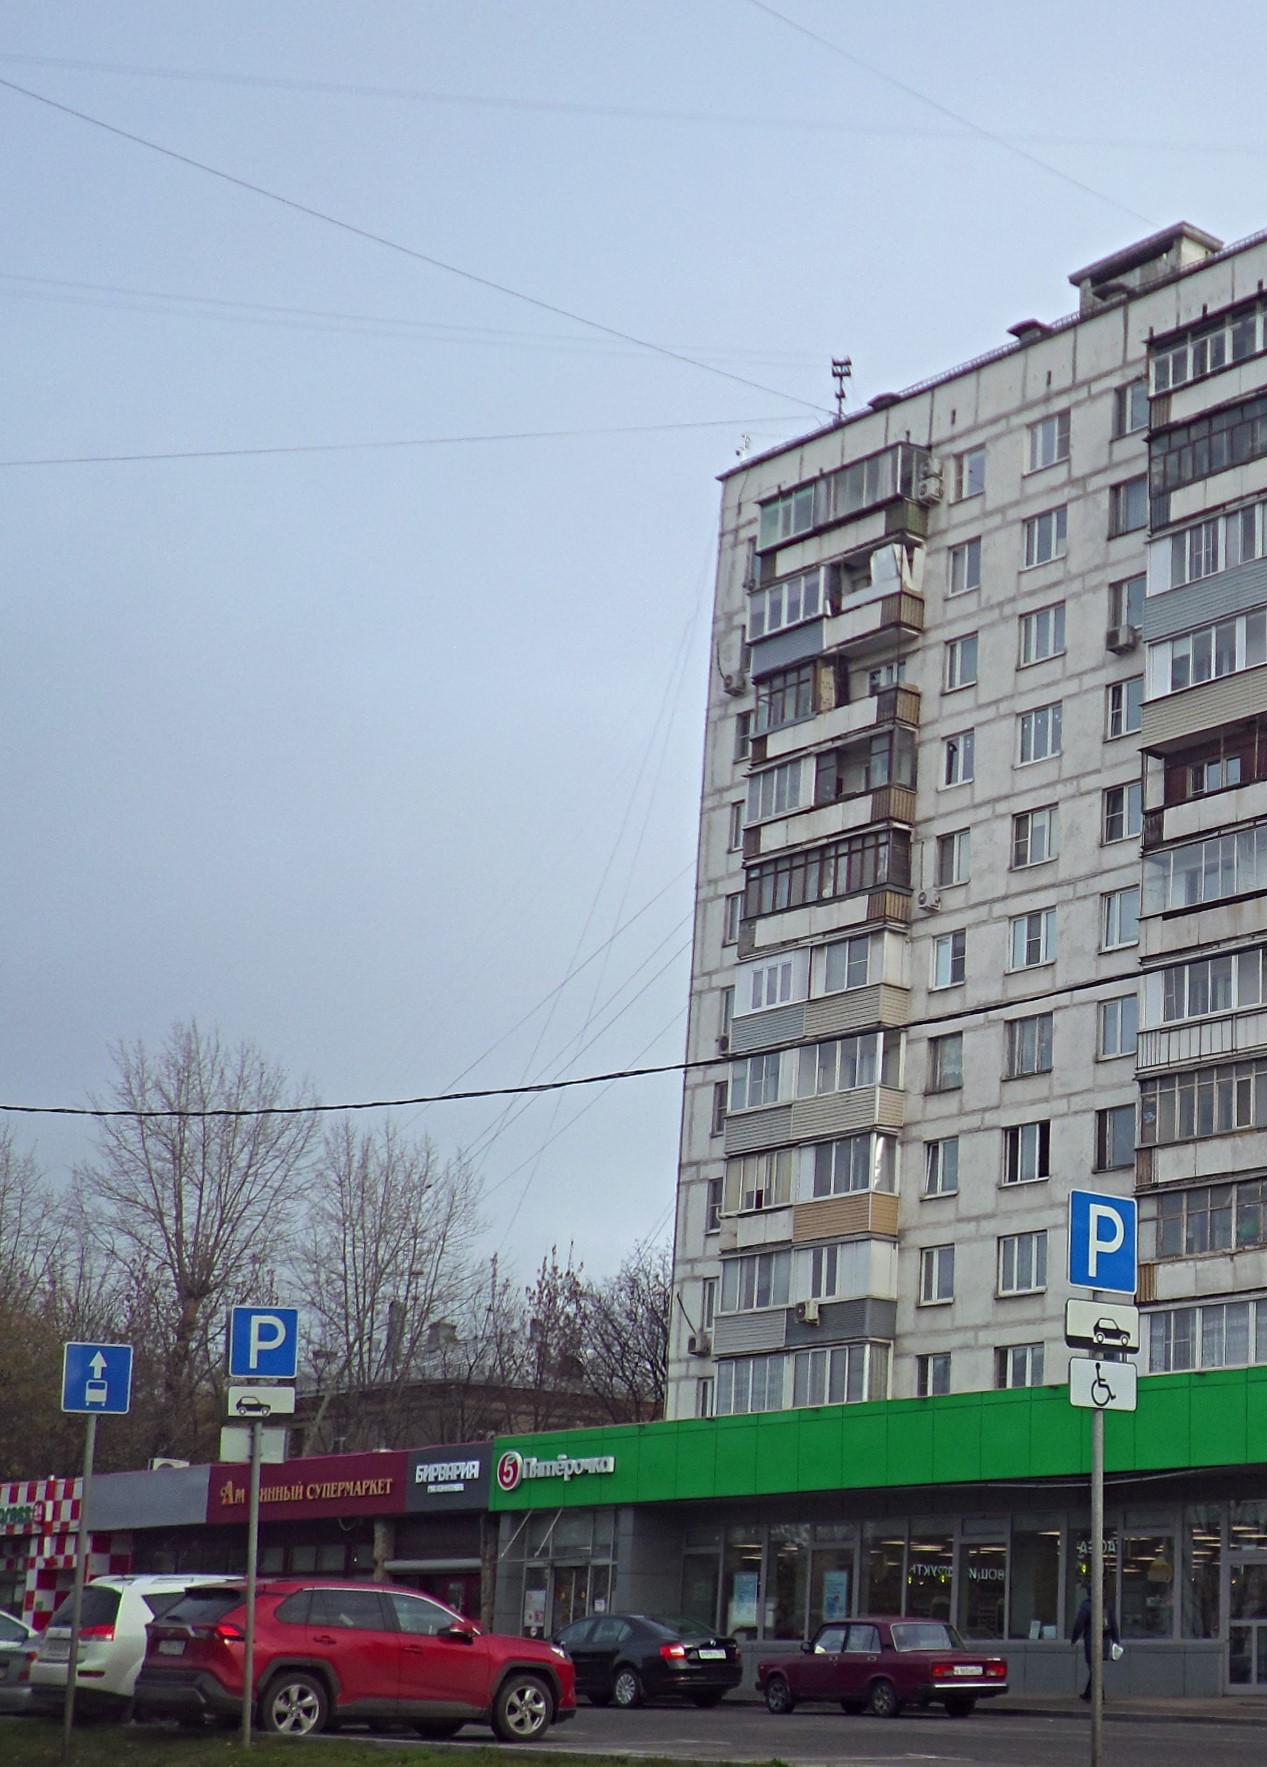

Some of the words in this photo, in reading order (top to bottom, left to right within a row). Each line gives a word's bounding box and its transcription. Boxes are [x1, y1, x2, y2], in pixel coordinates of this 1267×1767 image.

[1088, 1203, 1125, 1278] P
[249, 1314, 286, 1369] P
[257, 1481, 303, 1502] ИННЫЙ
[306, 1478, 393, 1500] СУПЕРМАРКЕТ
[415, 1461, 480, 1483] БИРВАРИЯ
